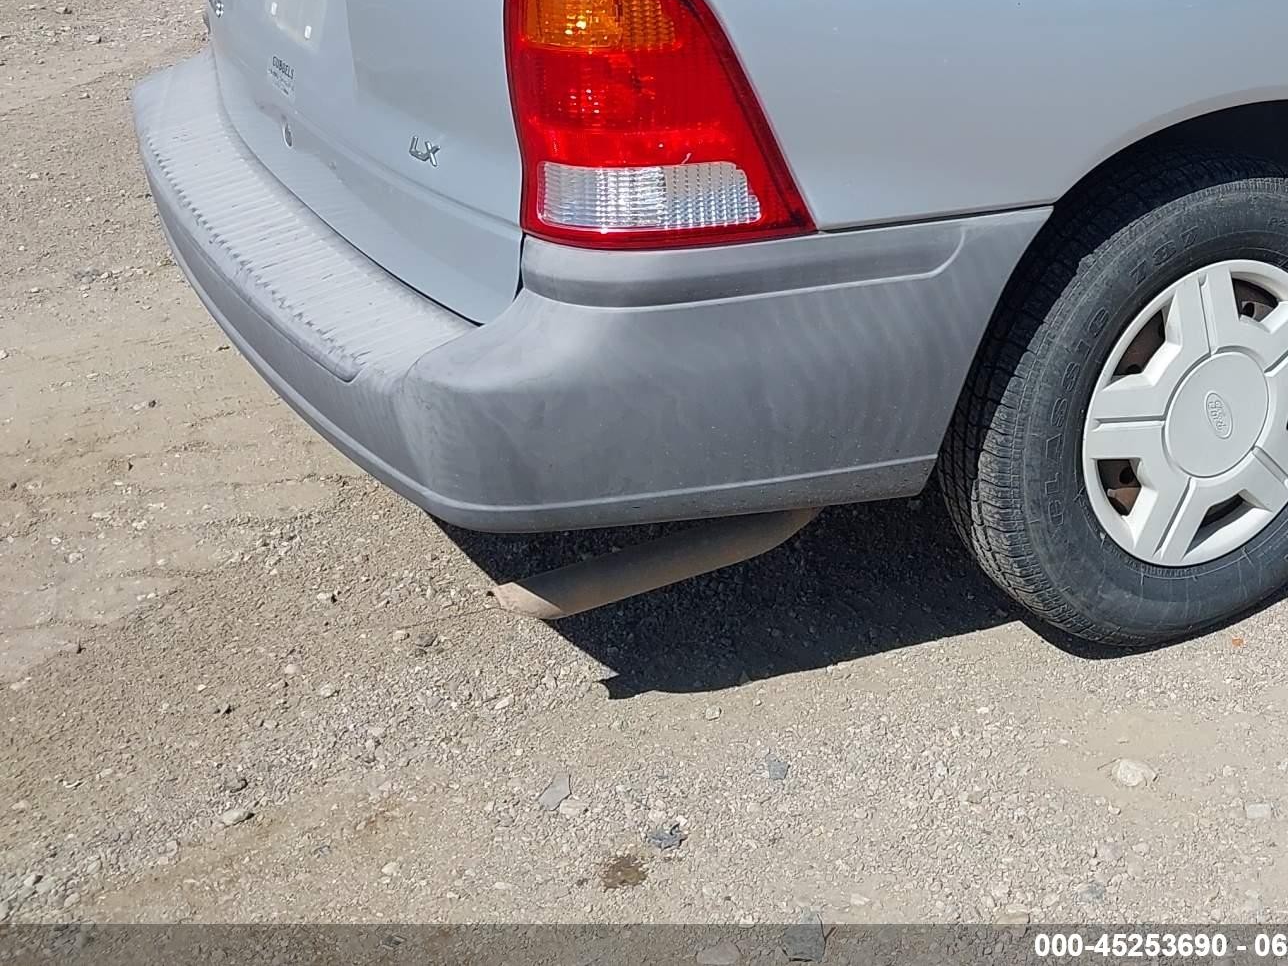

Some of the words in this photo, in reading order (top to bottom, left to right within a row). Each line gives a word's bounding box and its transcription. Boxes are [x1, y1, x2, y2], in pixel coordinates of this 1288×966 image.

[409, 135, 440, 167] LX
[1044, 306, 1110, 527] CLASSIC
[1128, 225, 1199, 285] 787
